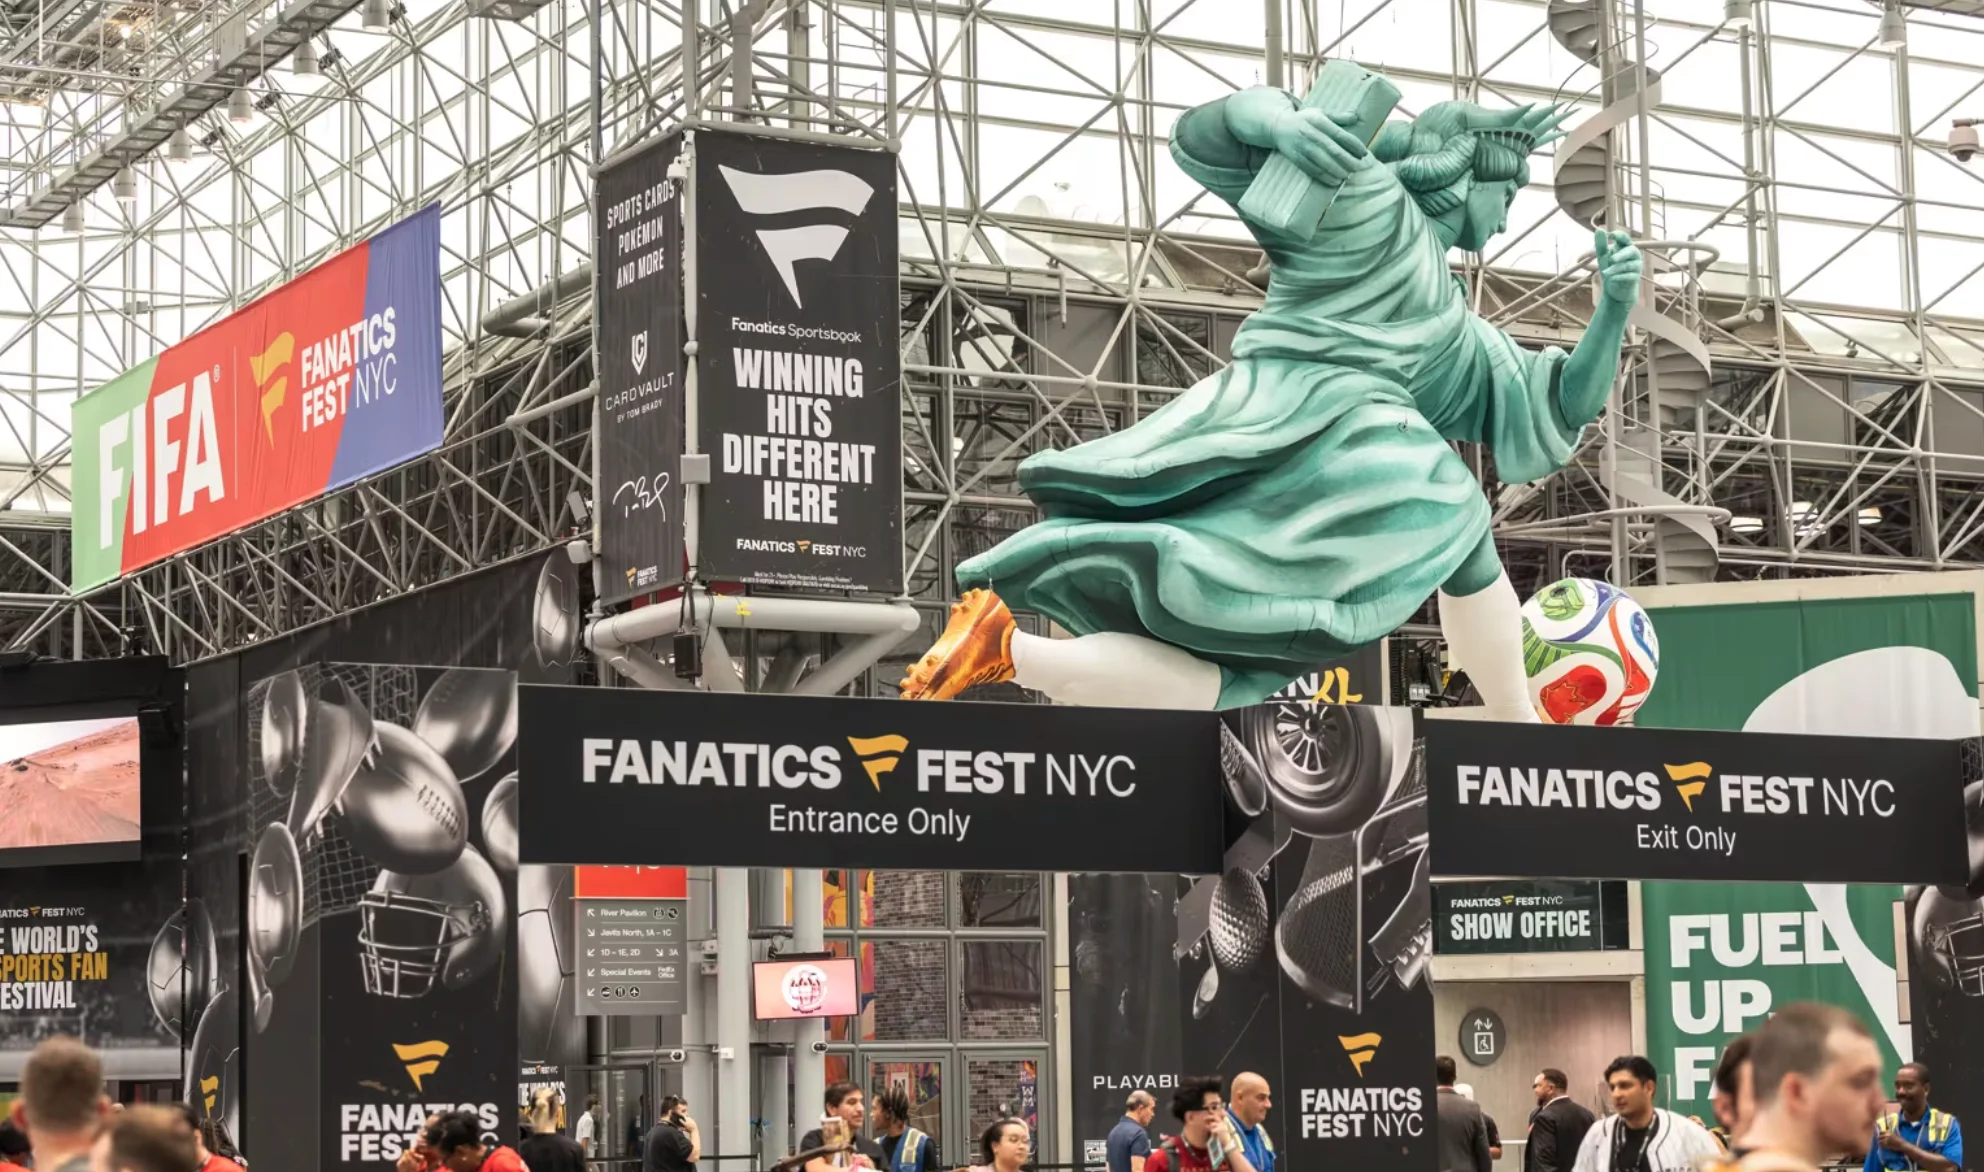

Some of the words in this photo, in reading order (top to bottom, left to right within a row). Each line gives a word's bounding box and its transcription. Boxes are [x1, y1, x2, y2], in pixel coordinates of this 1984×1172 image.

[607, 193, 642, 230] SPORTS
[645, 179, 675, 211] CARDS
[618, 215, 663, 257] POKÉMON
[616, 261, 635, 290] AND
[638, 247, 664, 280] MORE
[731, 316, 786, 335] Fanatics
[787, 323, 862, 343] Sportsbook
[302, 307, 397, 389] FANATICS
[733, 347, 864, 398] WINNING
[302, 373, 350, 432] FEST
[356, 353, 397, 408] NYC
[617, 413, 625, 424] BY
[626, 407, 640, 419] TOM
[641, 398, 663, 414] BRADY
[767, 394, 832, 438] HITS
[722, 433, 876, 484] DIFFERENT
[763, 479, 838, 525] HERE
[736, 538, 795, 553] FANATICS
[812, 544, 841, 556] FEST
[843, 546, 867, 558] NYC
[582, 738, 842, 789] FANATICS
[917, 748, 1036, 795] FEST
[1045, 754, 1137, 798] NYC
[1456, 765, 1662, 811] FANATICS
[1719, 773, 1814, 814] FEST
[1822, 778, 1896, 817] NYC
[769, 804, 898, 835] Entrance
[907, 807, 971, 842] Only
[1637, 823, 1679, 850] Exit
[1686, 825, 1737, 856] Only
[0, 908, 29, 918] ATICS
[42, 908, 65, 918] FEST
[66, 907, 85, 916] NYC
[600, 908, 619, 917] River
[620, 908, 647, 917] Pavilion
[1451, 898, 1501, 908] FANATICS
[1515, 896, 1541, 906] FEST
[1542, 895, 1563, 905] NYC
[11, 924, 99, 955] WORLD'S
[646, 929, 655, 937] 1A
[1450, 912, 1513, 940] SHOW
[1520, 909, 1591, 938] OFFICE
[1669, 911, 1844, 968] FUEL
[0, 953, 65, 983] PORTS
[70, 952, 108, 981] FAN
[601, 949, 610, 957] 1D
[630, 949, 641, 957] 2D
[668, 949, 679, 957] 3A
[600, 968, 627, 978] Special
[628, 968, 652, 977] Events
[1671, 980, 1777, 1035] UP
[1301, 1087, 1422, 1113] FANATICS
[1301, 1114, 1369, 1139] FEST
[1374, 1113, 1423, 1138] NYC
